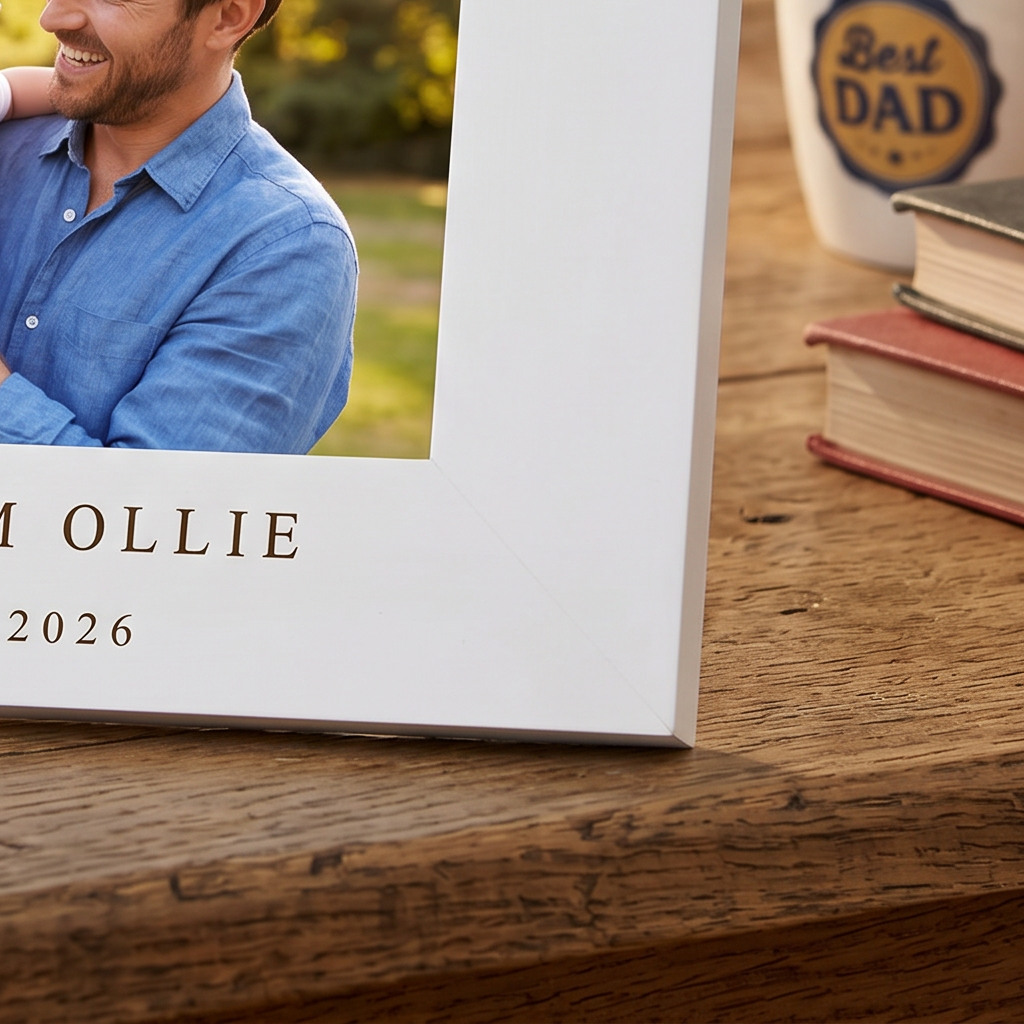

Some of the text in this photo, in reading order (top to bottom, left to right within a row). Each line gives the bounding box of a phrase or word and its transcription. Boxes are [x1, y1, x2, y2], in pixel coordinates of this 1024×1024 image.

[838, 21, 943, 74] Best
[833, 74, 965, 136] DAD
[63, 504, 299, 559] OLLIE
[7, 609, 134, 647] 2026
